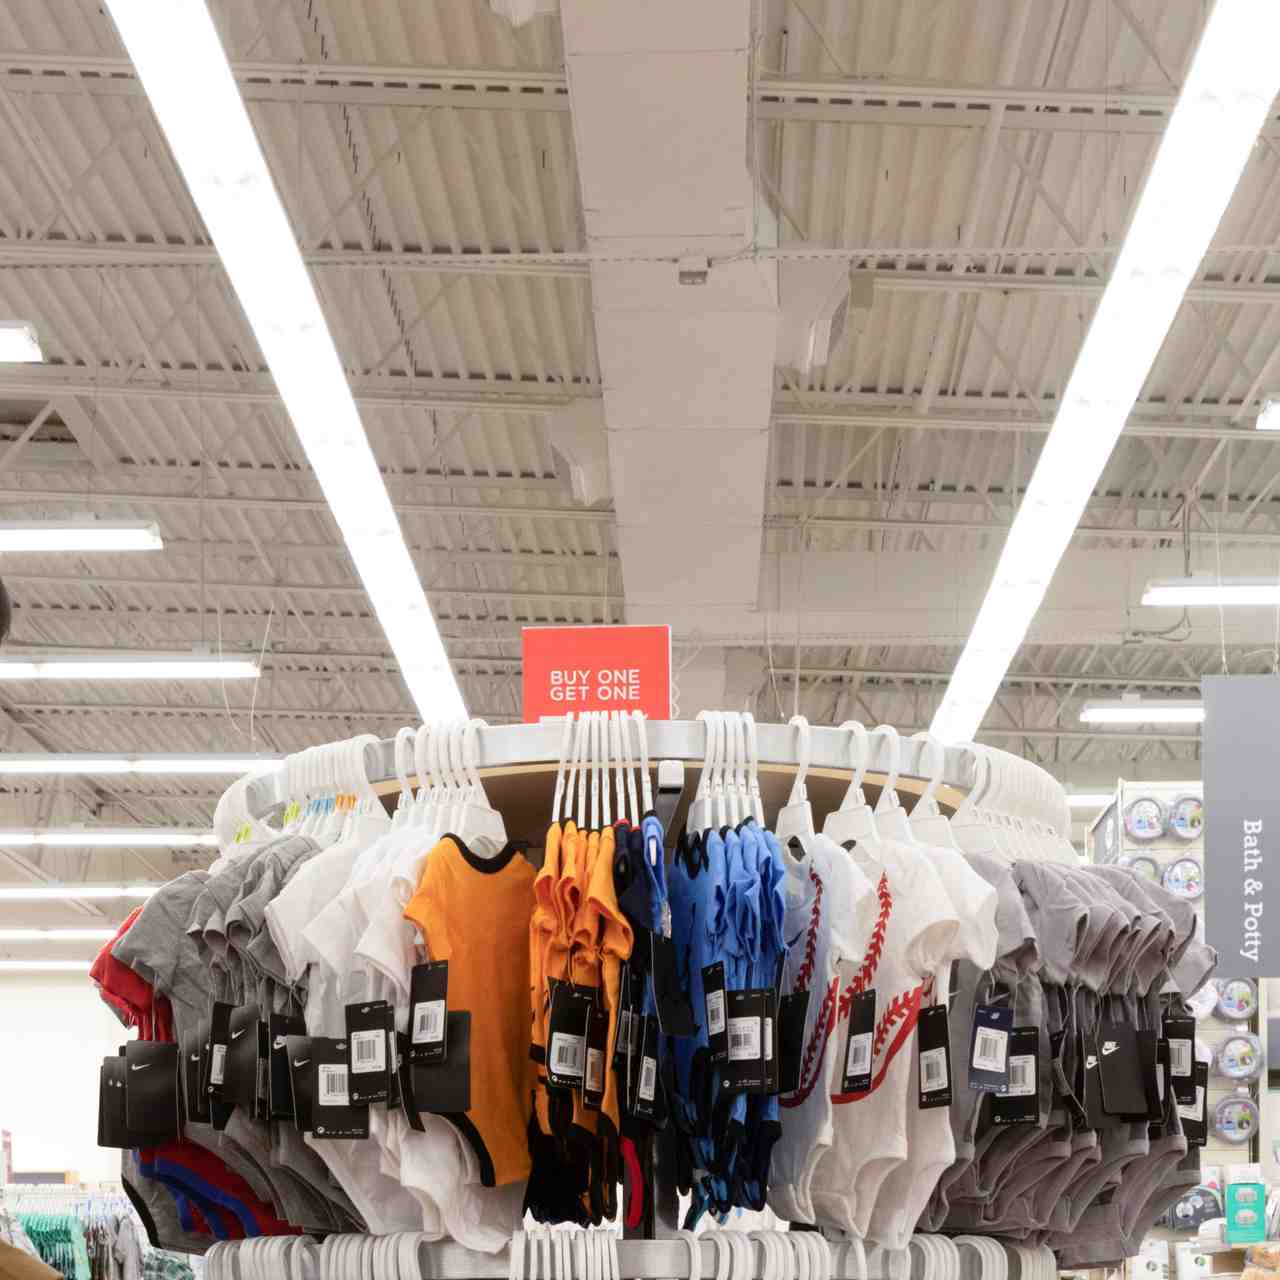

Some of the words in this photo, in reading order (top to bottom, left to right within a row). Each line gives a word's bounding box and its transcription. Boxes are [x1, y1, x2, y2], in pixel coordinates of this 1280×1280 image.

[549, 669, 591, 685] BUY
[597, 668, 640, 685] ONE
[549, 686, 589, 701] GET
[597, 685, 640, 700] ONE
[1243, 819, 1263, 872] Bath
[1243, 878, 1264, 896] &
[1239, 902, 1264, 962] Potty
